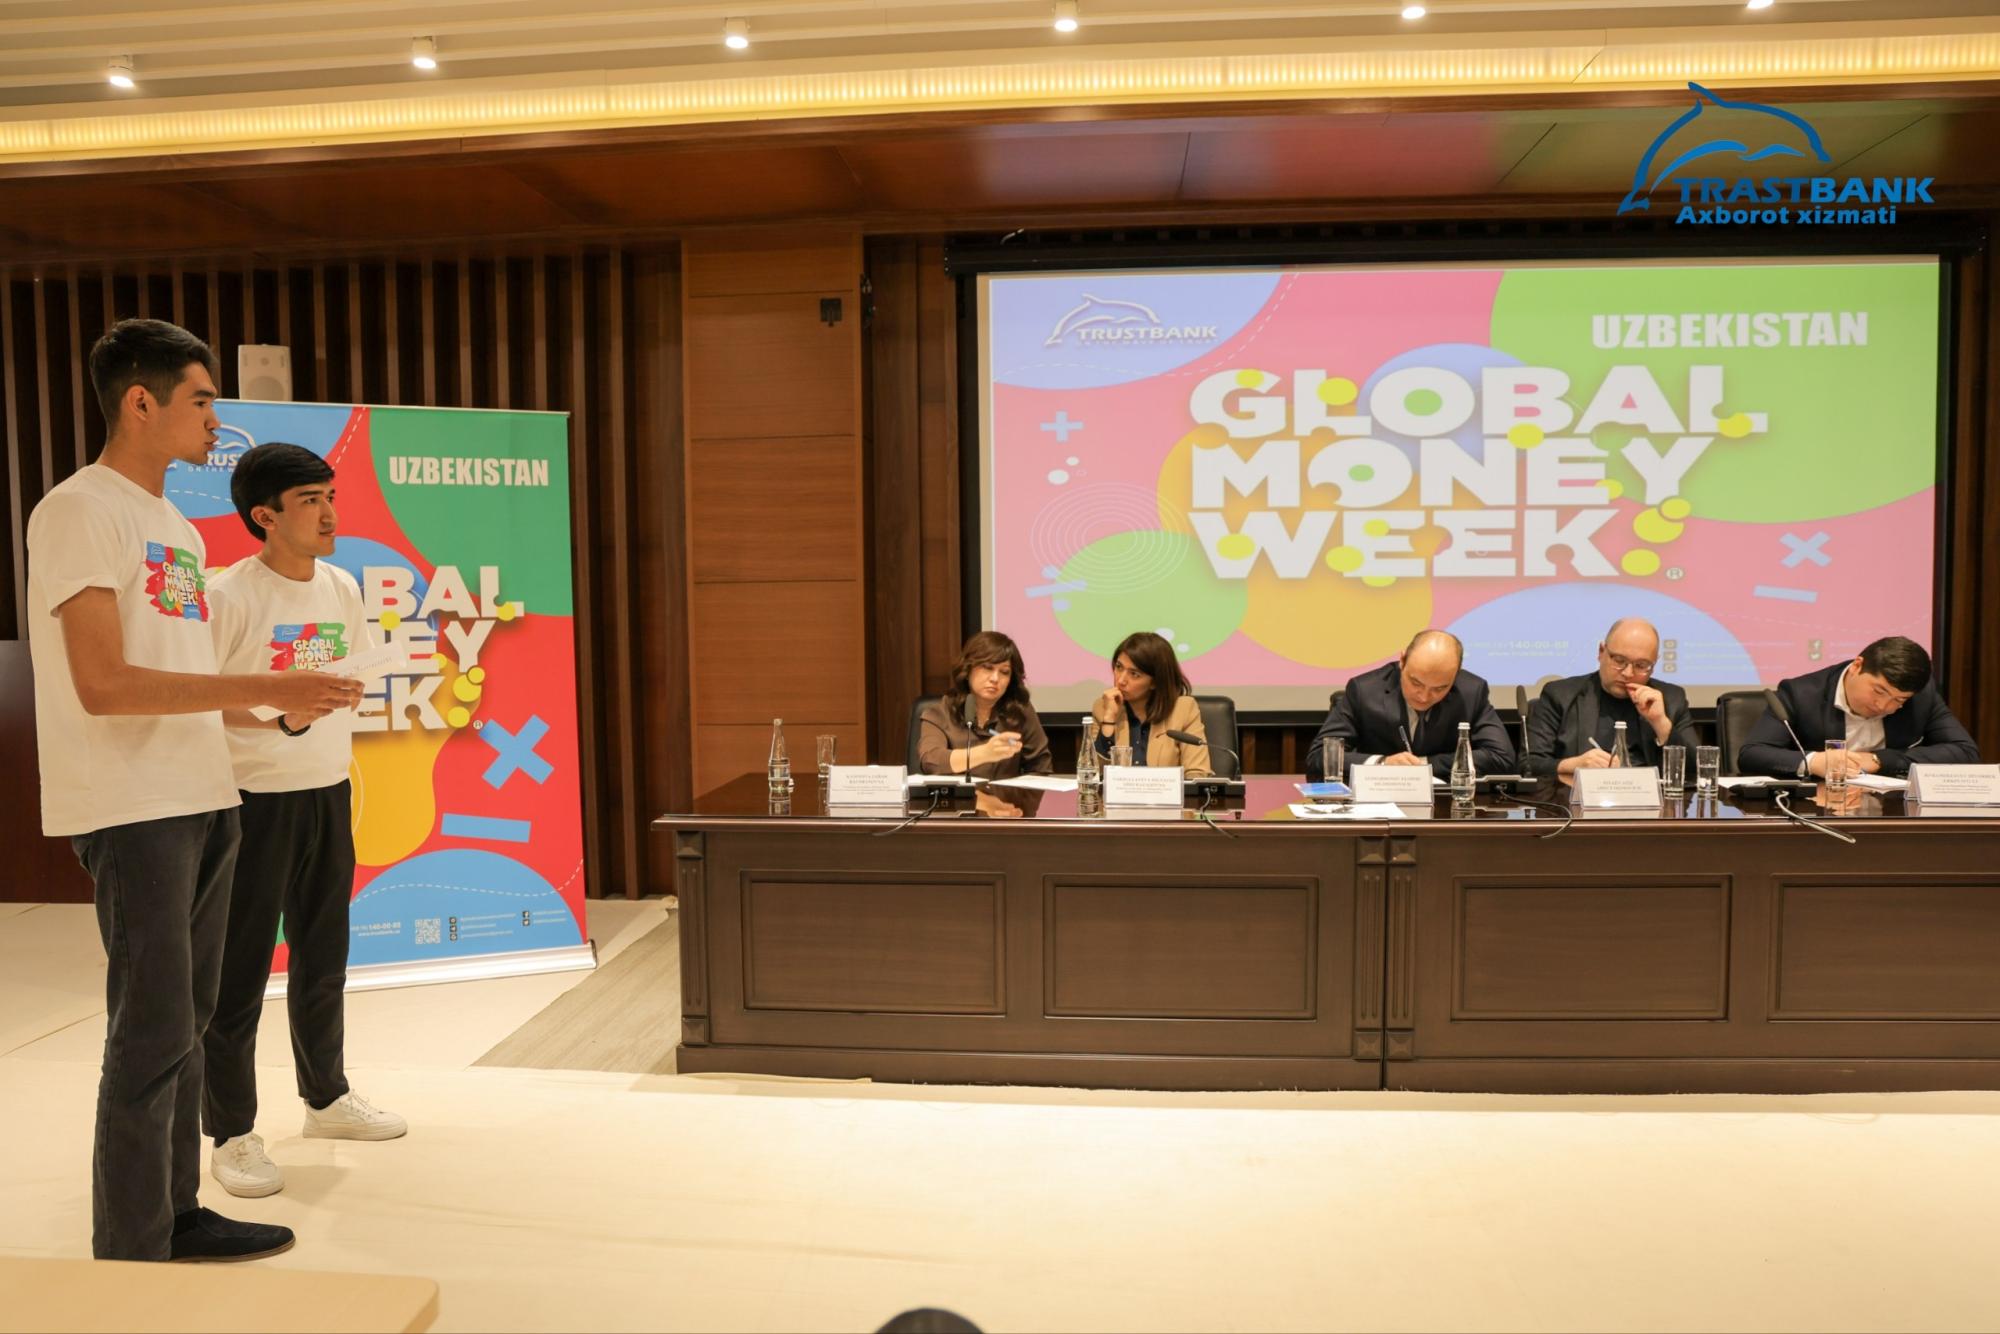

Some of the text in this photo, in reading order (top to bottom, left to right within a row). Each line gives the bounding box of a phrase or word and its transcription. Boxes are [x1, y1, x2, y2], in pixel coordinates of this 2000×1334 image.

[1076, 325, 1217, 340] TRUSTBANK
[1592, 312, 1868, 349] UZBEKISTAN
[1189, 365, 1769, 439] GLOBAL
[388, 456, 550, 487] UZBEKISTAN
[1191, 436, 1716, 508] MONEY
[1187, 508, 1620, 579] WEEK
[363, 565, 525, 620] BAL
[351, 675, 449, 732] EK
